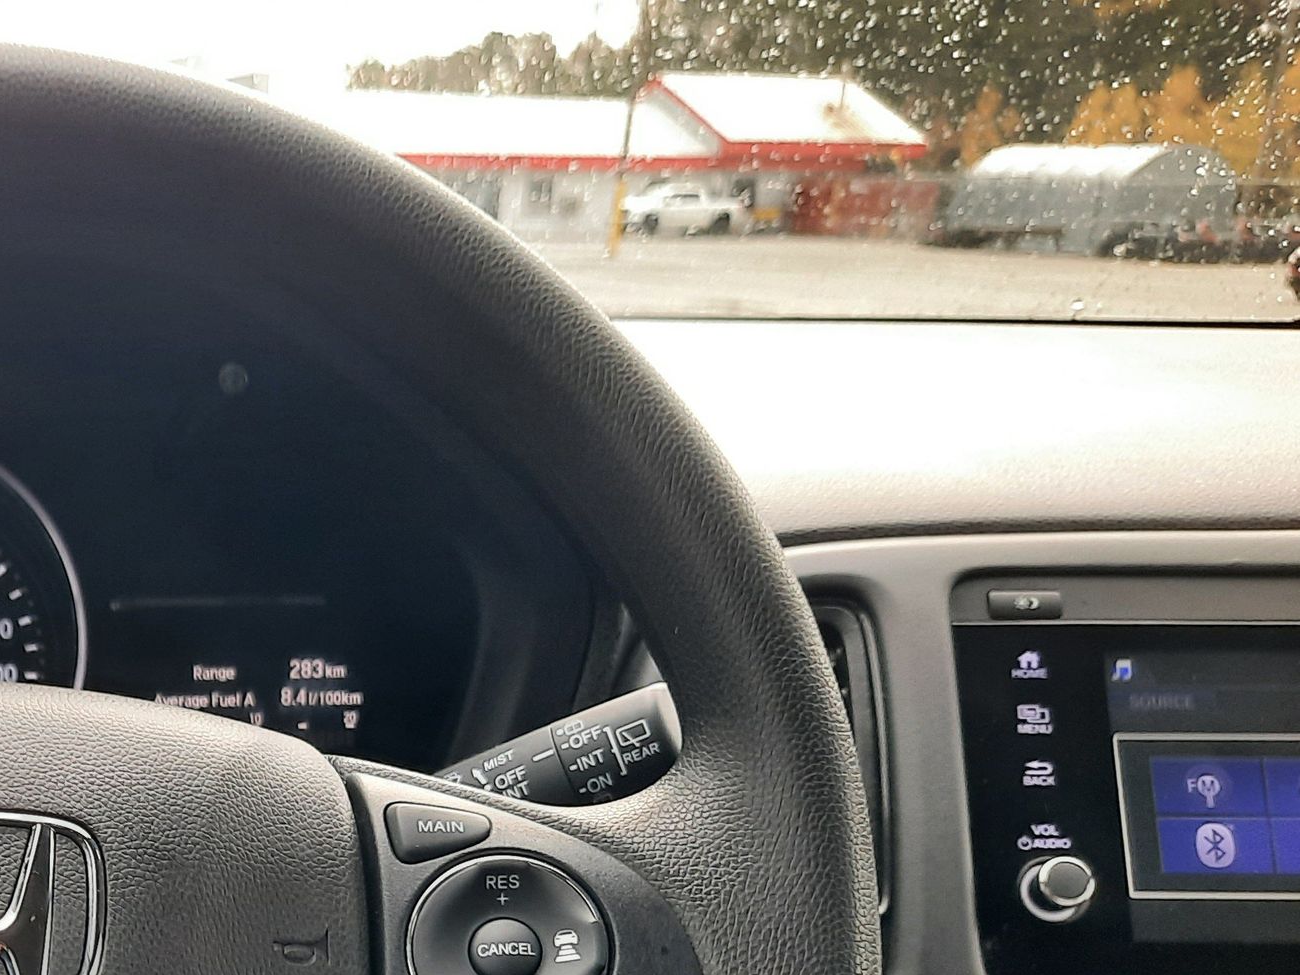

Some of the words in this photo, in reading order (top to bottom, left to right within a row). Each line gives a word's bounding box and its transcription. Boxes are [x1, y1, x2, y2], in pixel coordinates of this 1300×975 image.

[193, 665, 236, 682] Range
[211, 691, 240, 708] Fuel
[483, 749, 515, 772] MIST
[622, 742, 661, 765] REAR
[494, 764, 527, 790] OFF
[417, 820, 465, 833] MAIN
[1030, 824, 1059, 837] VOL
[486, 875, 520, 890] RES
[477, 942, 536, 958] CANCEL
